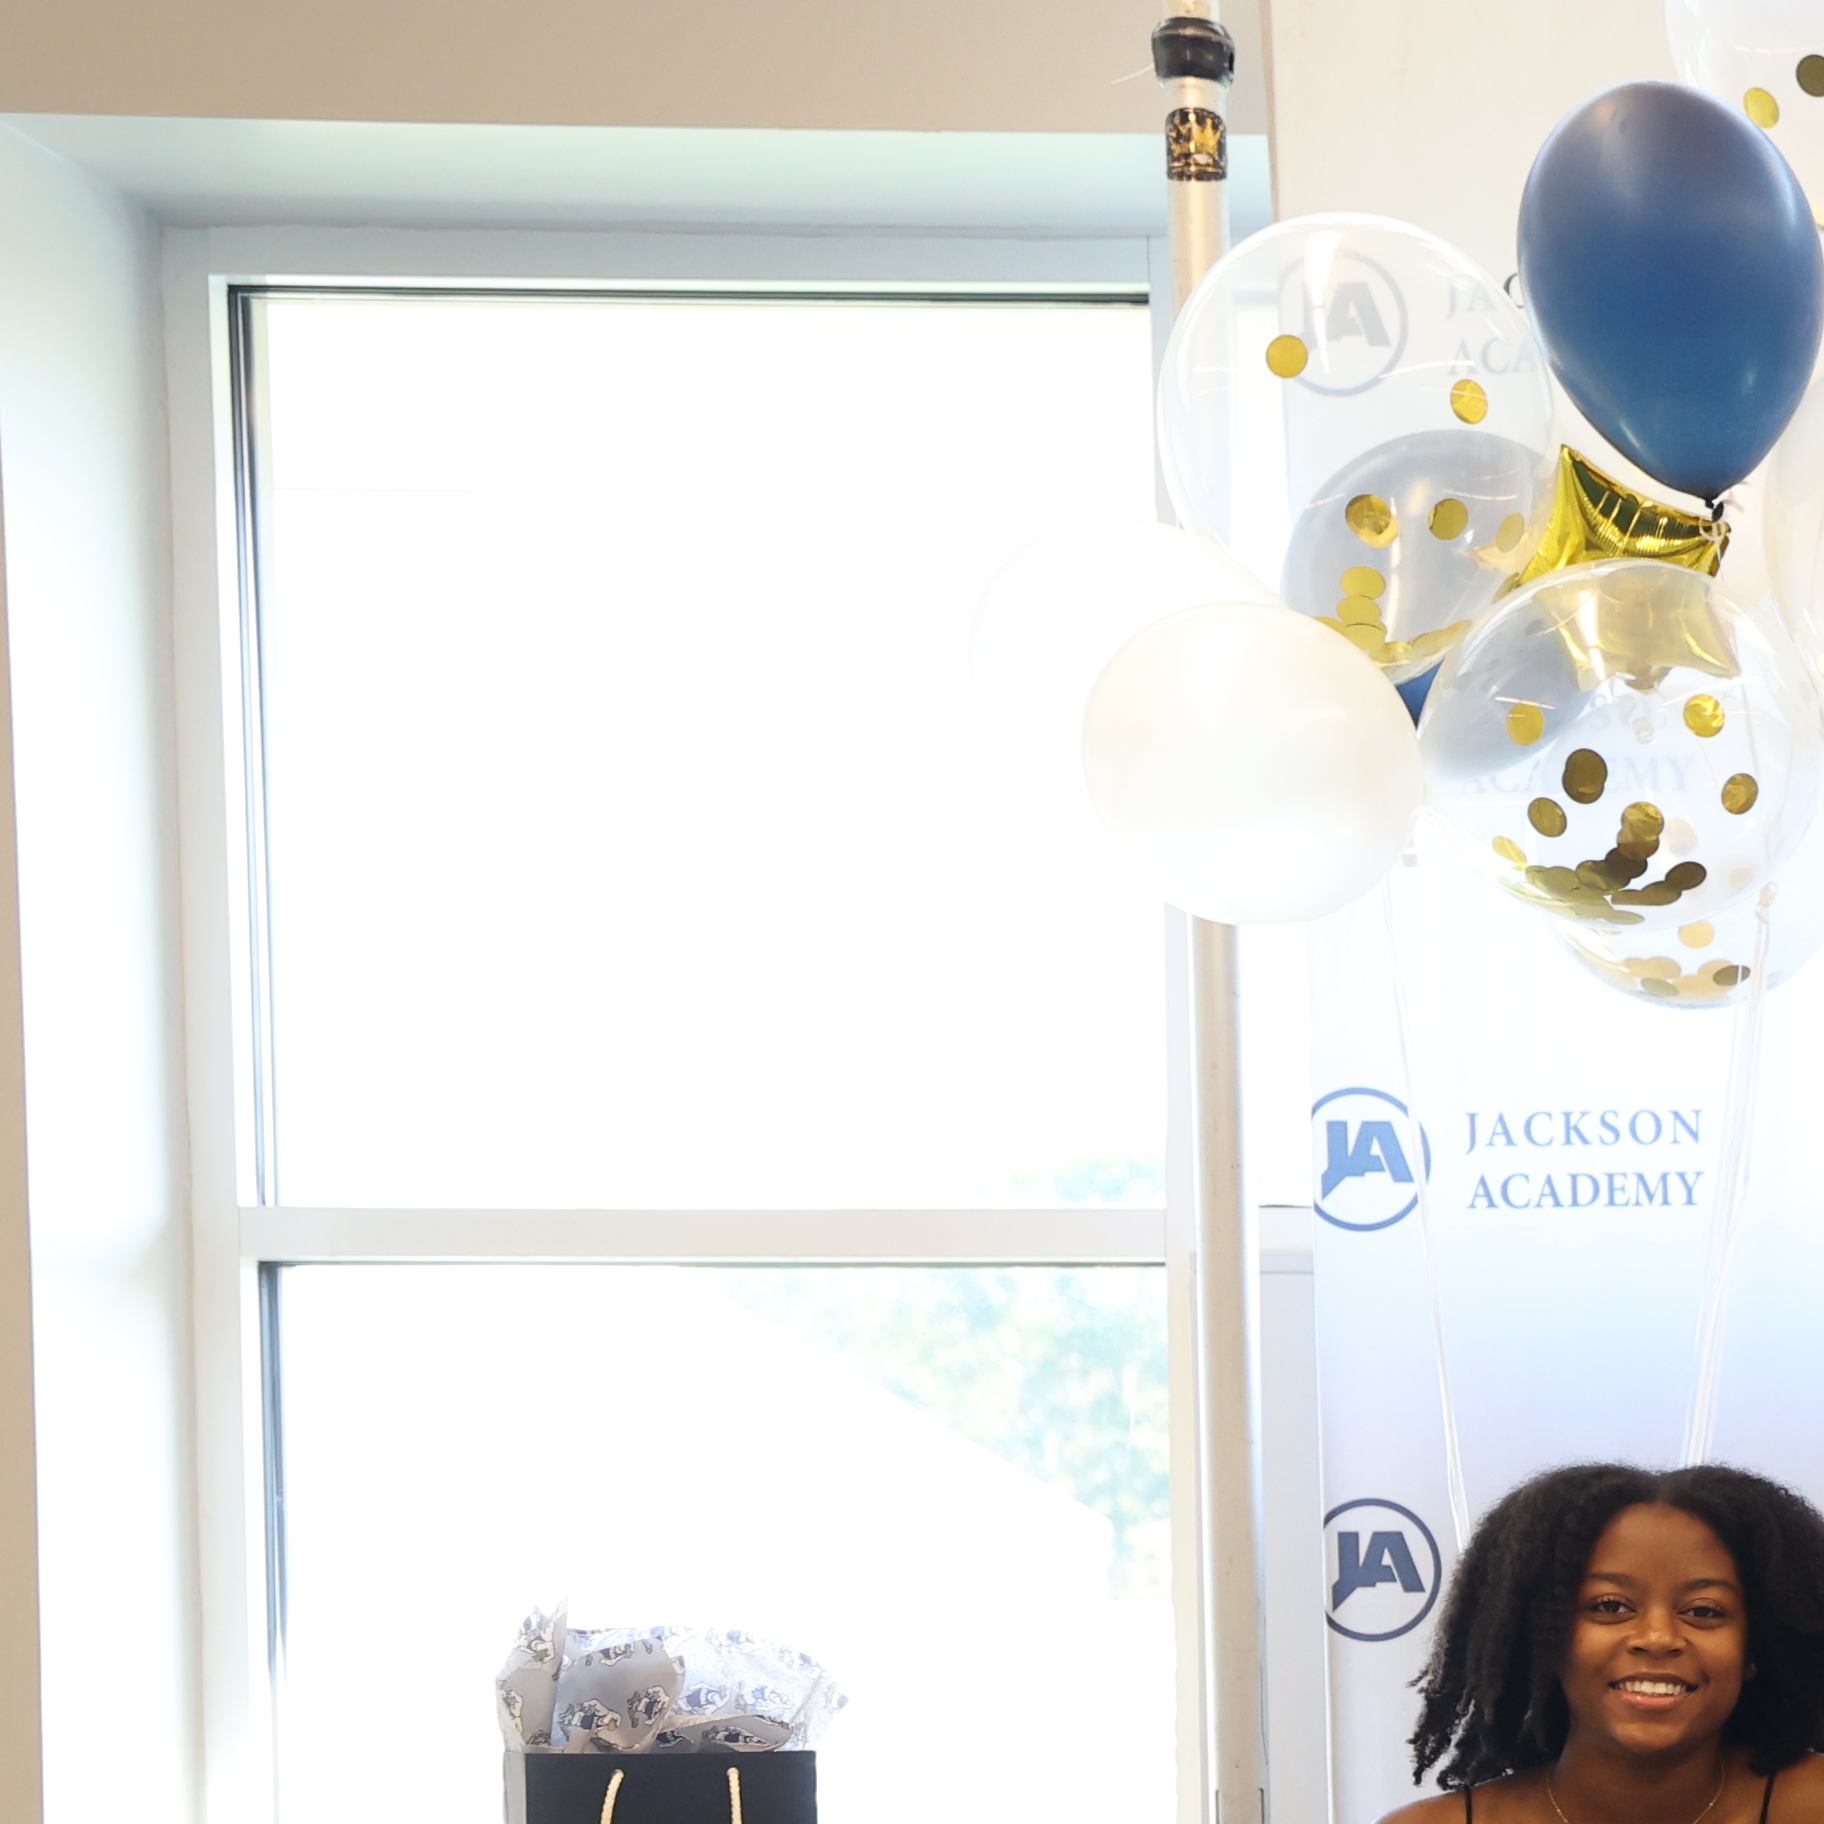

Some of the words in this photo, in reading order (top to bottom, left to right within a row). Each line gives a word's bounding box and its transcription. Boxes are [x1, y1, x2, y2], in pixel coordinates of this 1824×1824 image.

[1460, 754, 1694, 795] ACAEMY
[1465, 1109, 1702, 1153] JACKSON
[1467, 1171, 1704, 1210] ACADEMY
